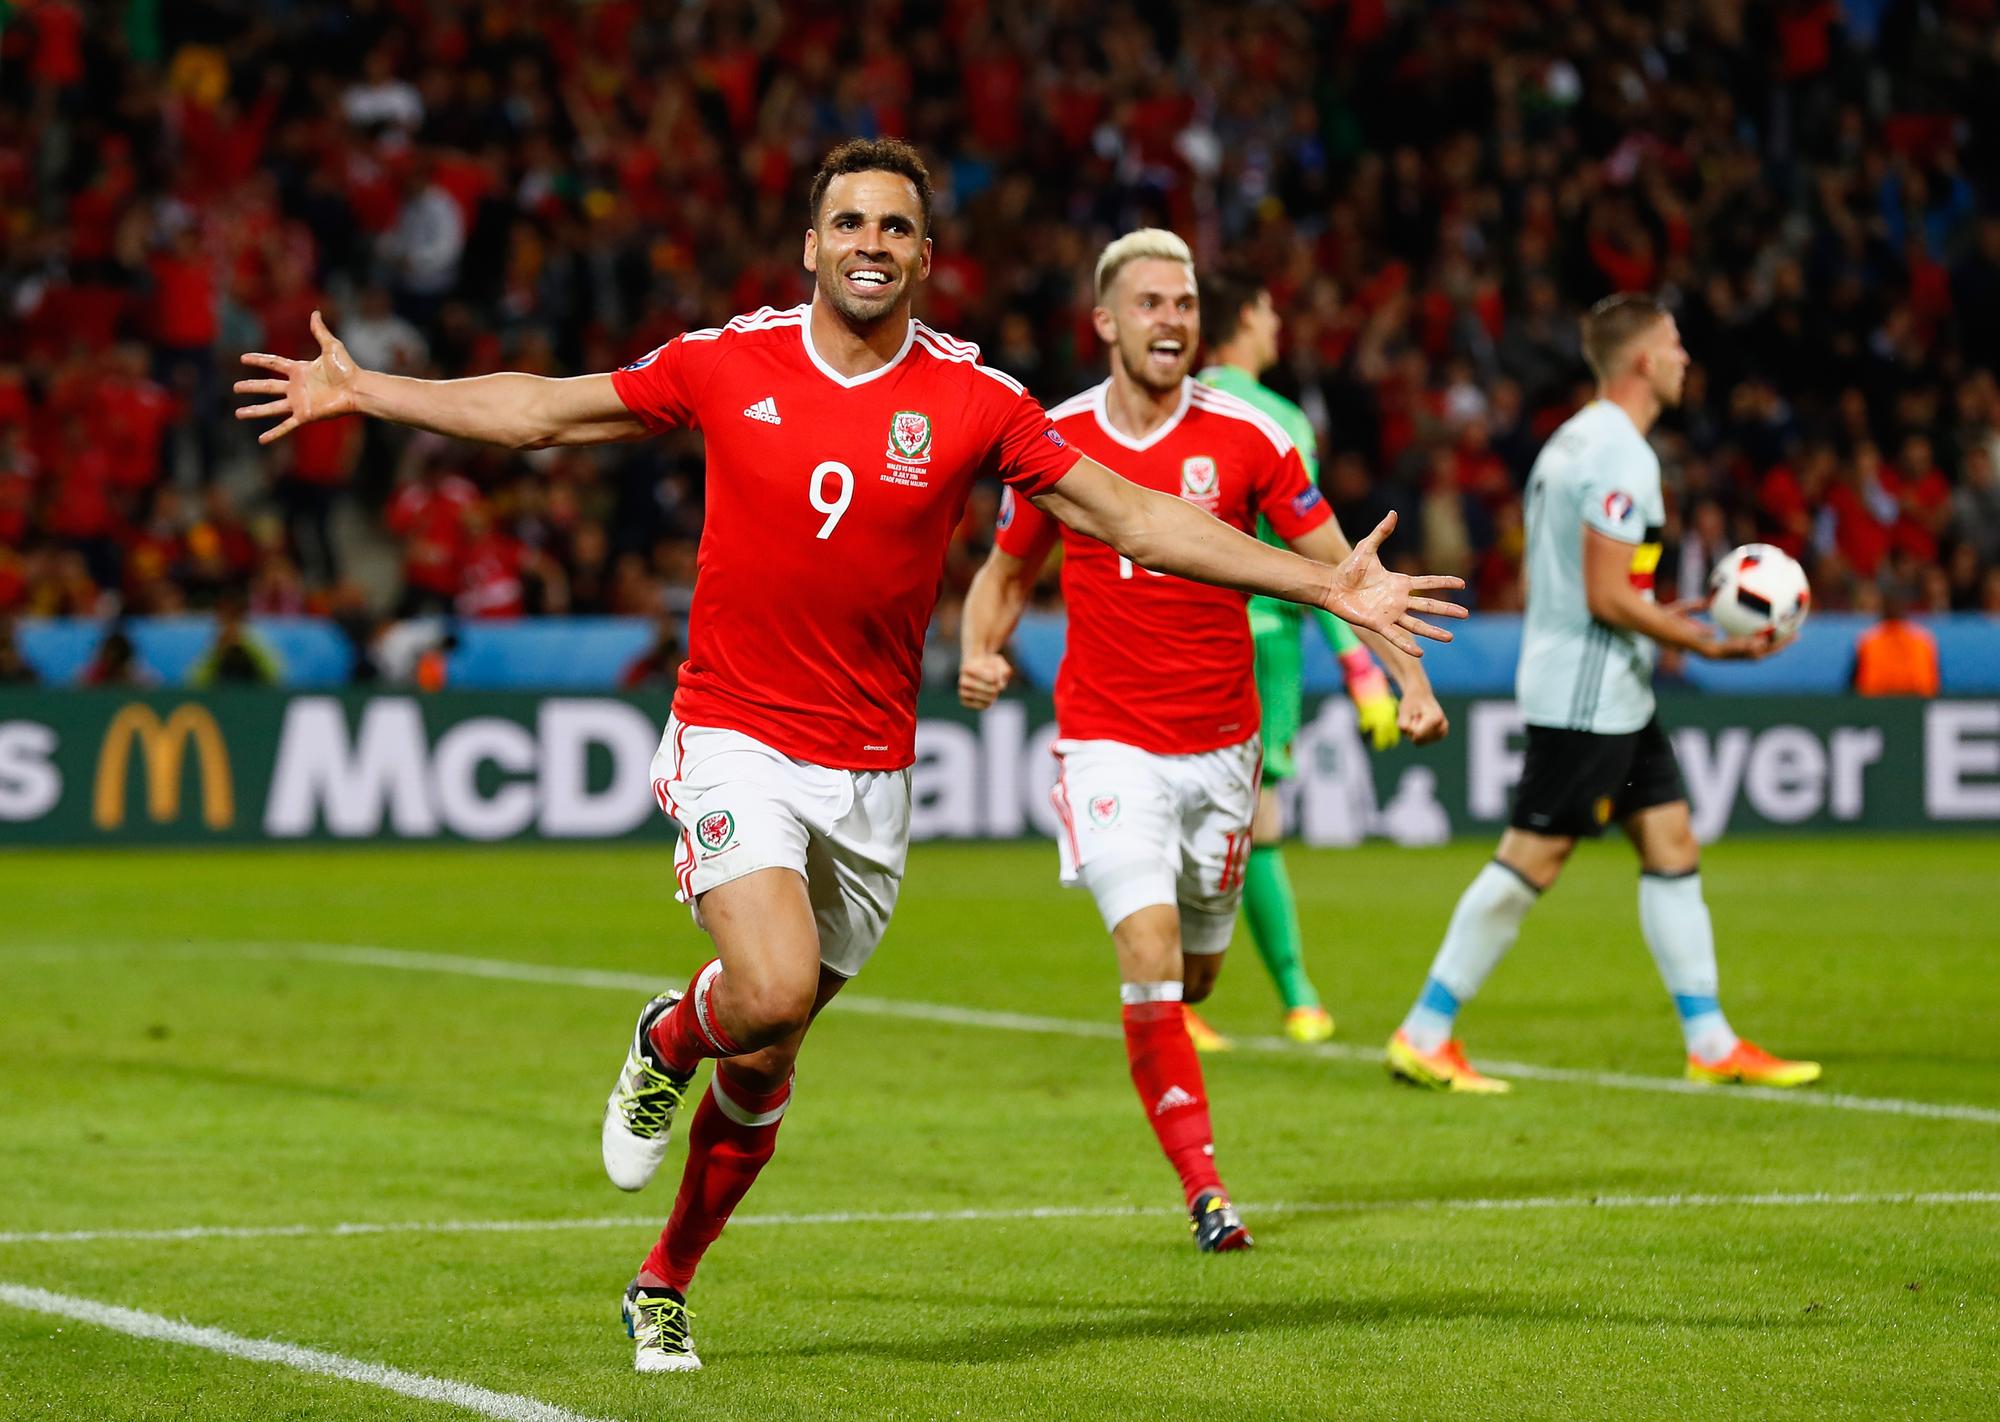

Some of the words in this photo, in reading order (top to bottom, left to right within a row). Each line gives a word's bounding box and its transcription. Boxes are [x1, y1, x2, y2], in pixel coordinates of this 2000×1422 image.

[744, 408, 781, 425] adidas
[809, 461, 854, 540] 9
[1468, 701, 1884, 844] Pyer
